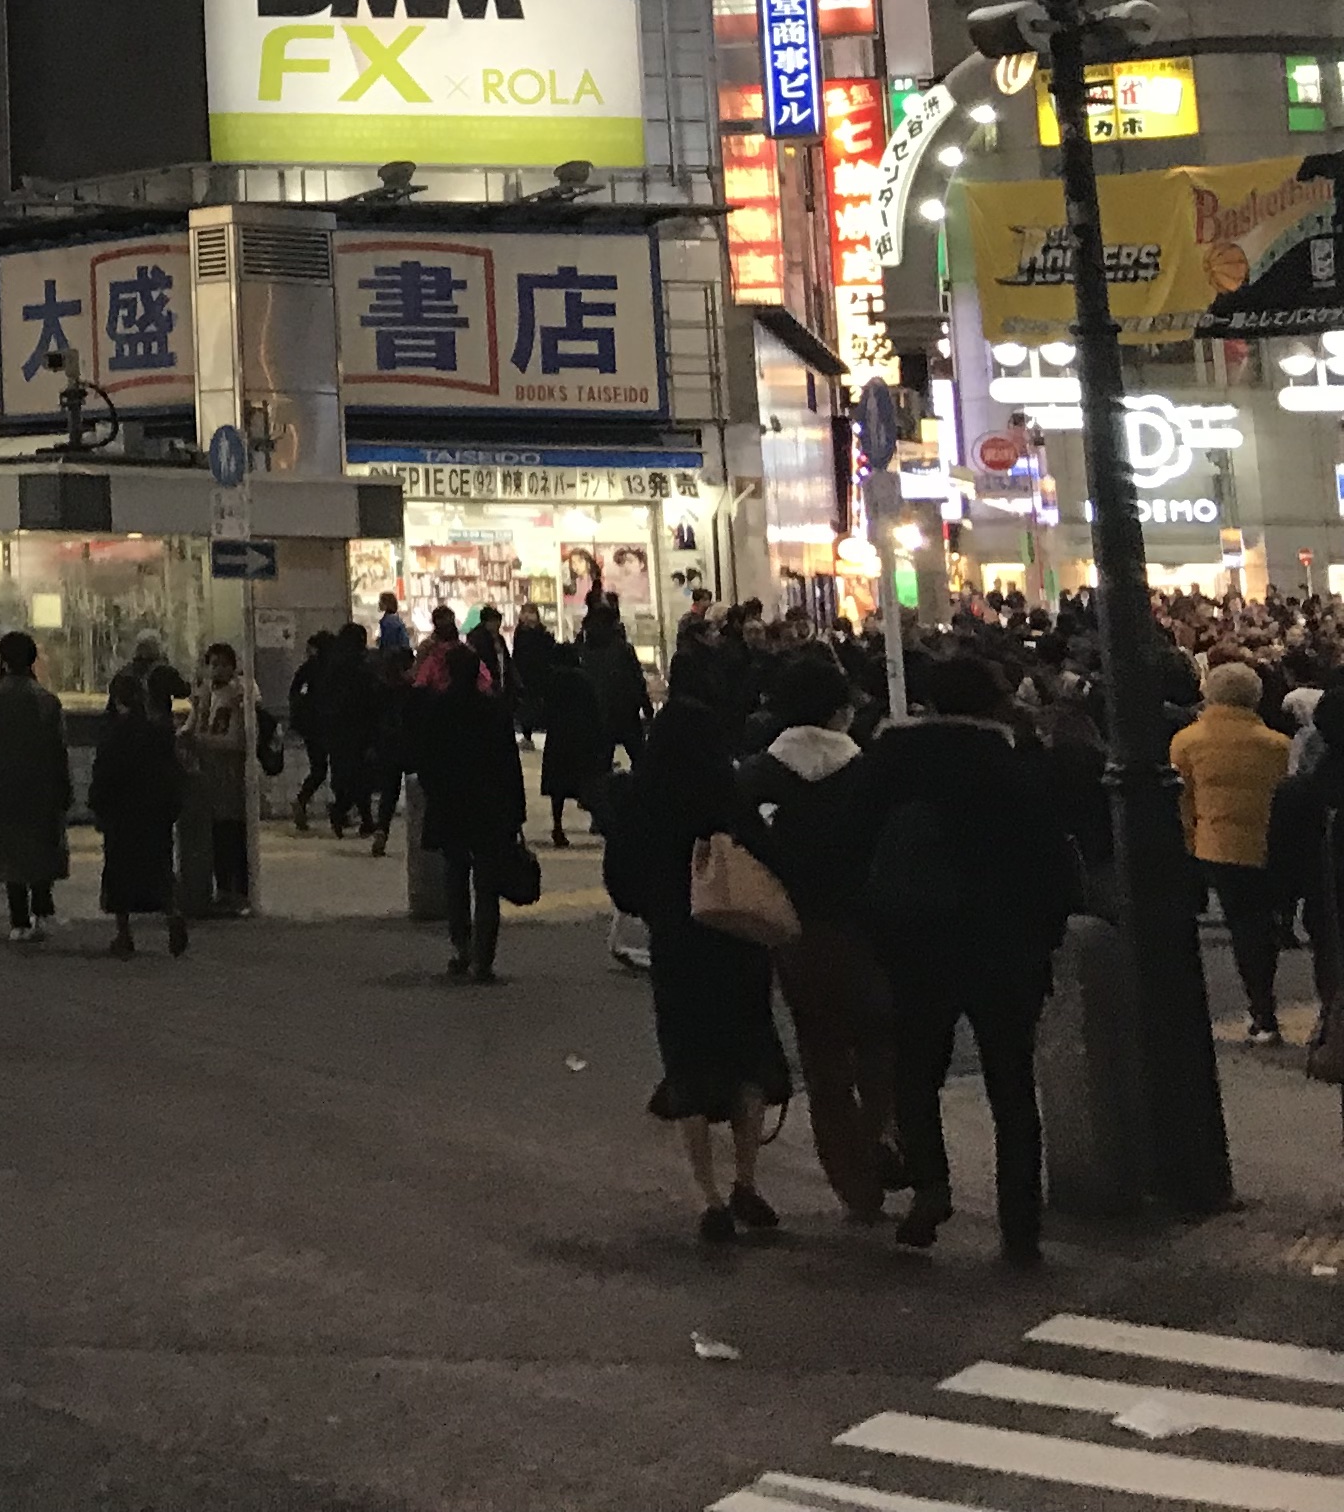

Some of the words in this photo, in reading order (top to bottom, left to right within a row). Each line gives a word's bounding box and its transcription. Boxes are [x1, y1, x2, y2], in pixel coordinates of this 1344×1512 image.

[257, 25, 432, 105] FX
[482, 68, 605, 106] ROLA
[876, 95, 941, 261] 渋谷センター街
[357, 259, 619, 376] 書店
[515, 384, 569, 403] BOOKS
[576, 385, 650, 404] TAISEIDO
[423, 448, 542, 465] TAISEIDO
[1136, 498, 1218, 523] DEMO
